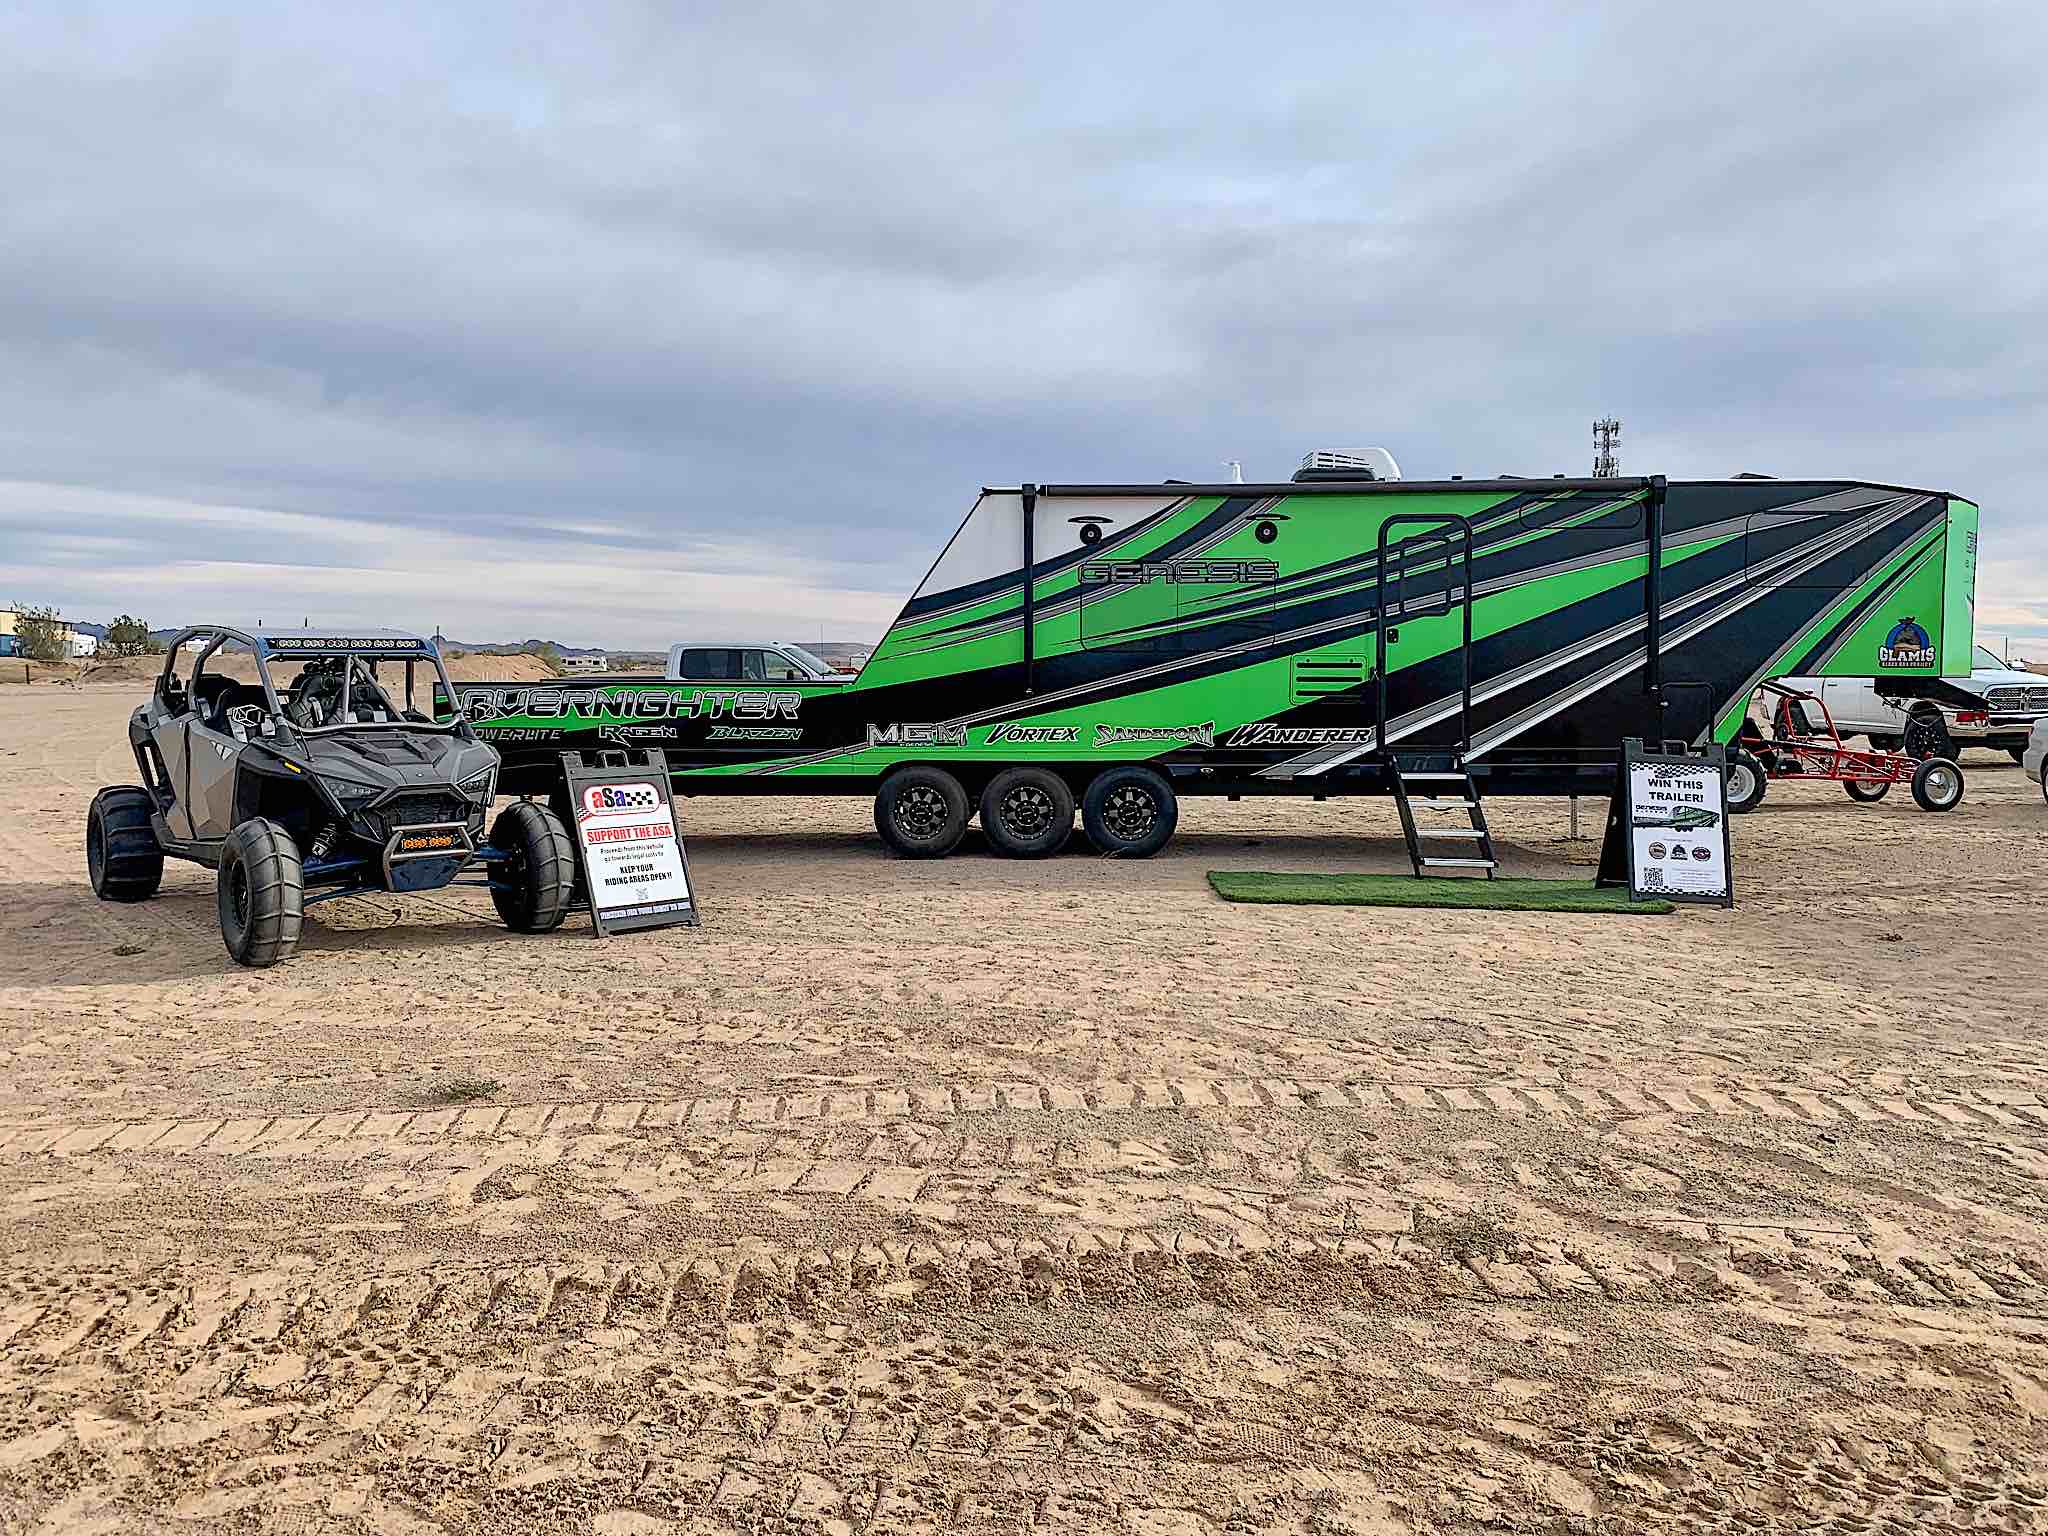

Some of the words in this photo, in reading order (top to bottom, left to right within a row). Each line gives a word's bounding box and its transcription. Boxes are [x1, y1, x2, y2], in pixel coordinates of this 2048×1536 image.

[1078, 560, 1280, 585] GENESIS
[1879, 646, 1935, 662] GLAMIS
[462, 689, 802, 719] OVERNIGHTER
[472, 728, 561, 740] OWERLITE
[598, 724, 678, 747] RAGEN
[867, 723, 967, 747] MGM
[984, 723, 1081, 746] VORTEX
[1093, 720, 1215, 748] SANDSPORT
[1226, 723, 1372, 746] WANDERER
[1648, 778, 1672, 788] WIN
[1675, 779, 1703, 790] THIS
[1648, 791, 1704, 803] TRAILER!
[586, 828, 632, 843] SUPPORT
[633, 826, 651, 838] THE
[652, 824, 672, 837] ASA
[619, 865, 636, 874] KEEP
[636, 863, 654, 872] YOUR
[604, 876, 629, 887] RIDING
[629, 874, 649, 884] AREAS
[650, 872, 667, 881] OPEN
